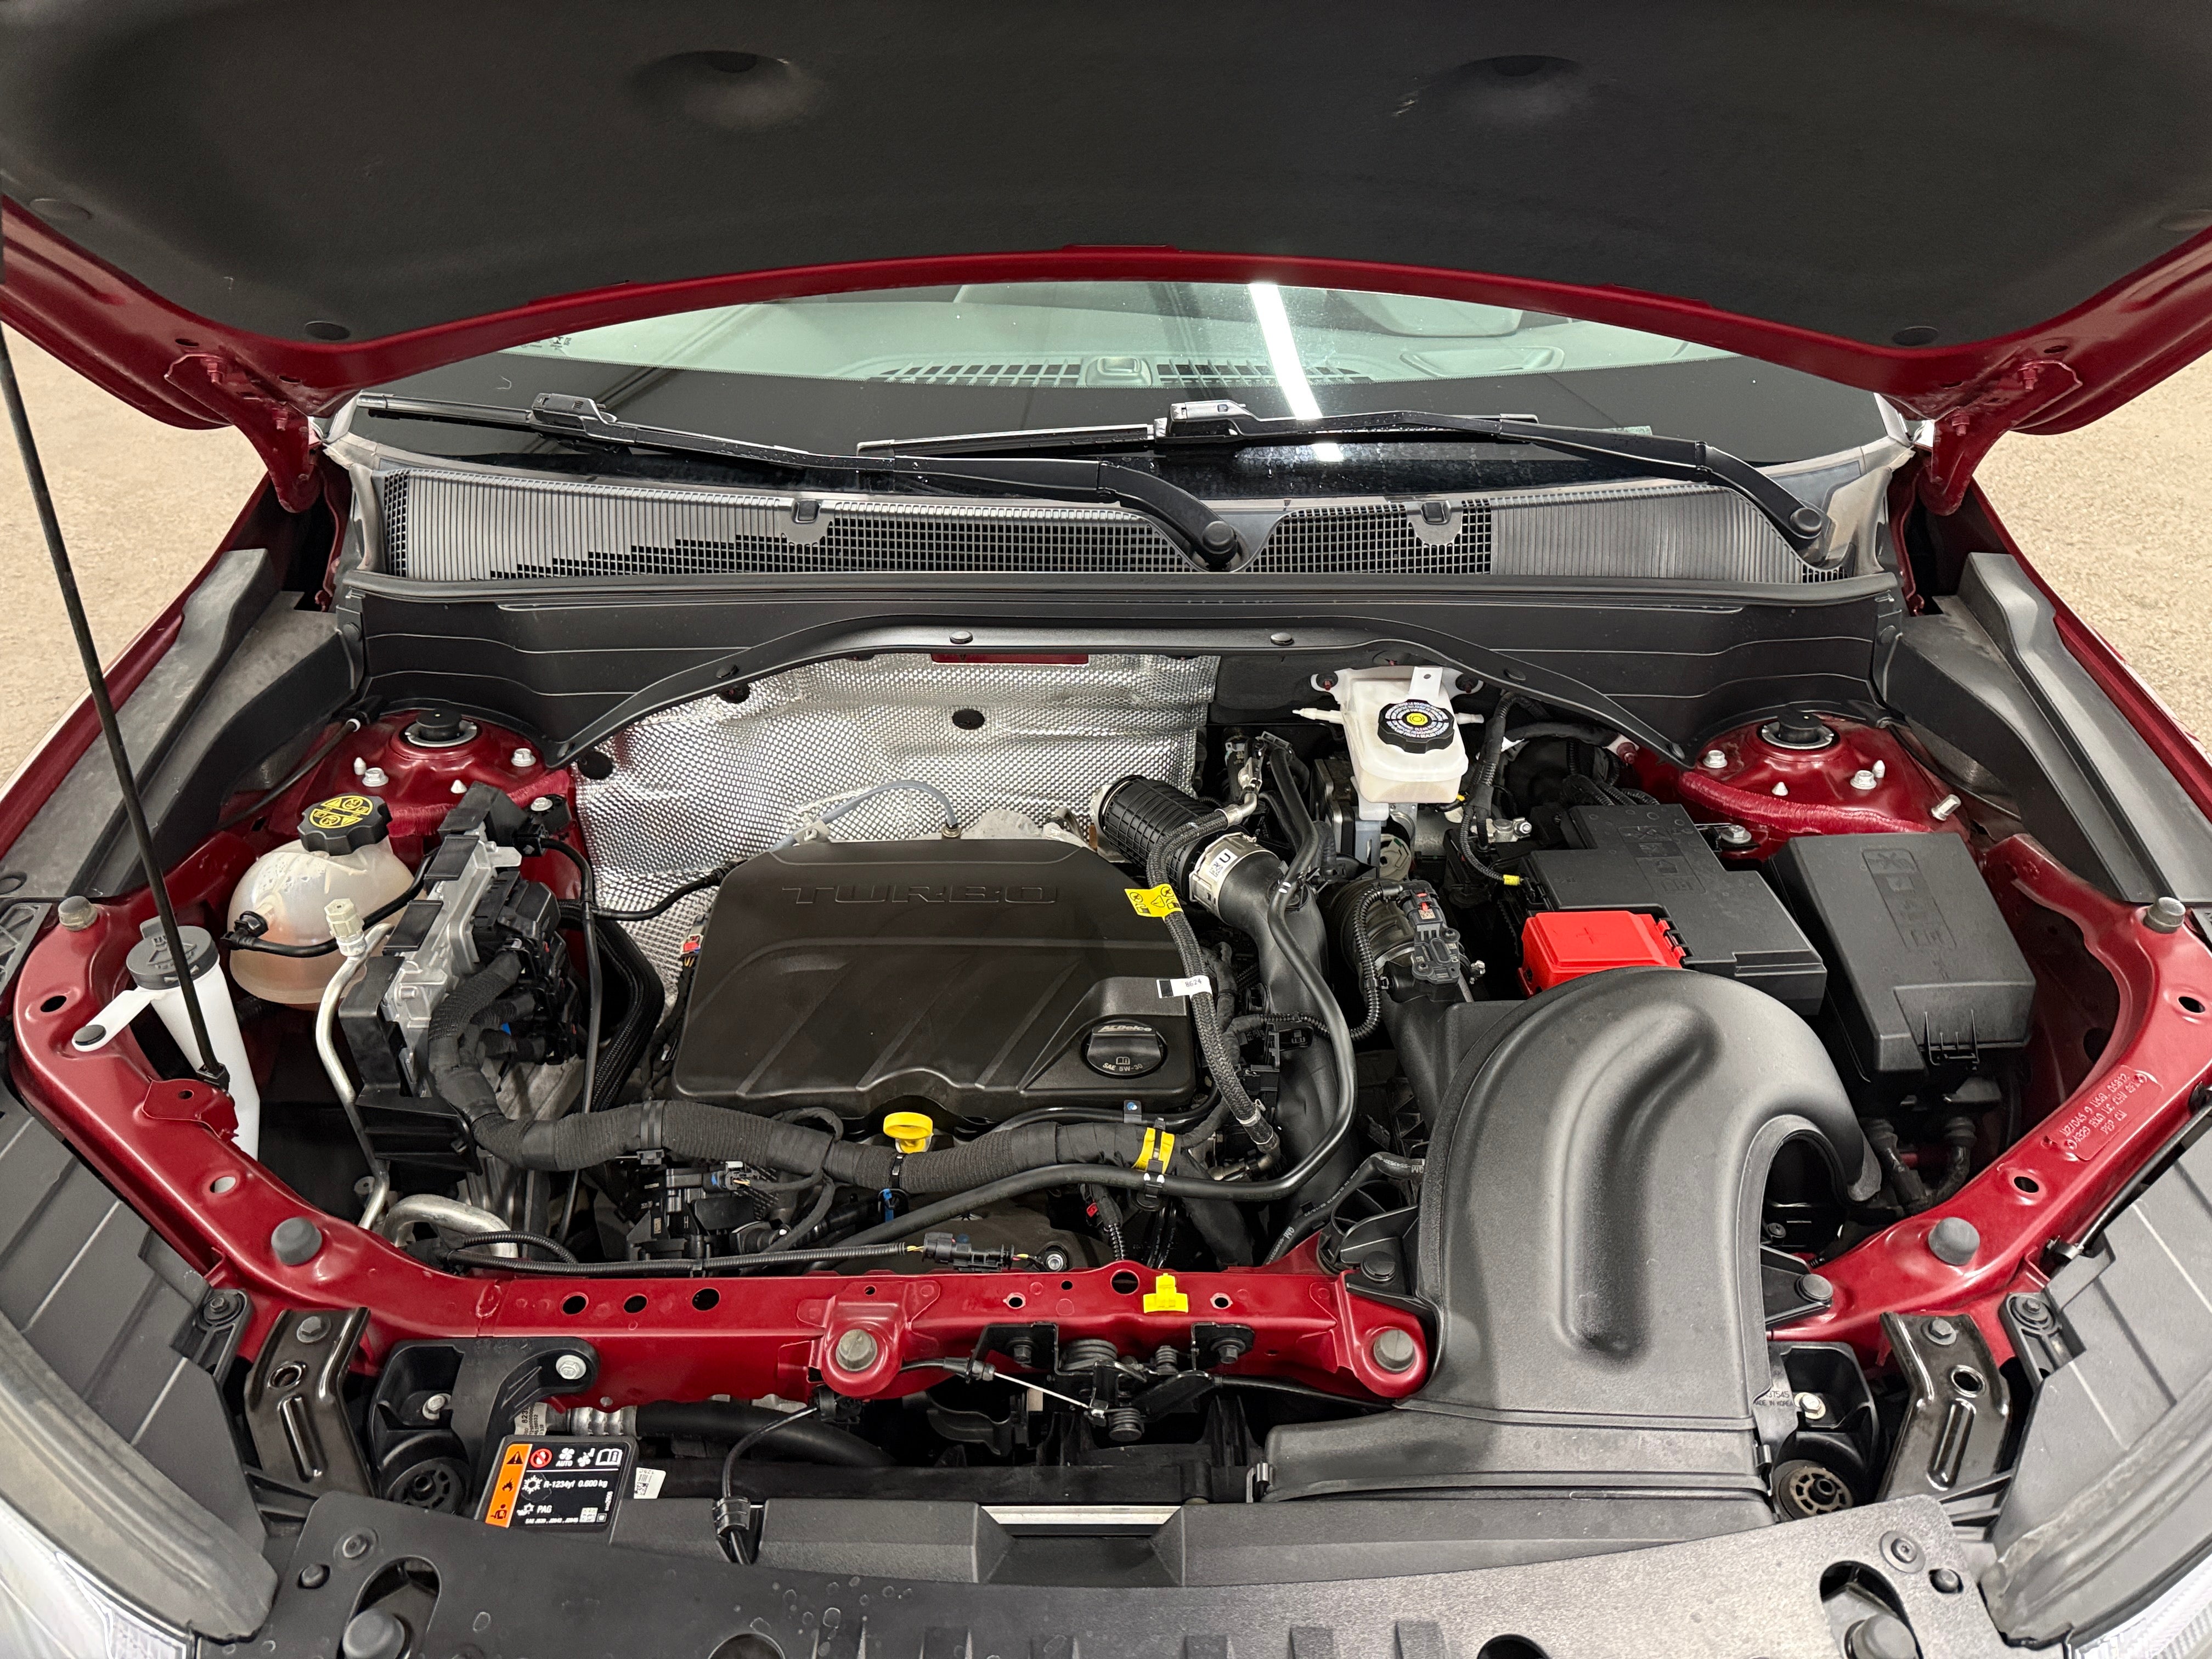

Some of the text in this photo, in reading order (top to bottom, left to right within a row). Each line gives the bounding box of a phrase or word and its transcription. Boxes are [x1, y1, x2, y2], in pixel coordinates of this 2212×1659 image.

[782, 884, 1058, 904] TURBO
[1185, 978, 1202, 988] 8624
[1102, 1062, 1143, 1072] SAE 5W-30
[1283, 1226, 1295, 1239] GM
[543, 1480, 608, 1489] R-1234yf 0.600 kg
[537, 1505, 552, 1513] PAG
